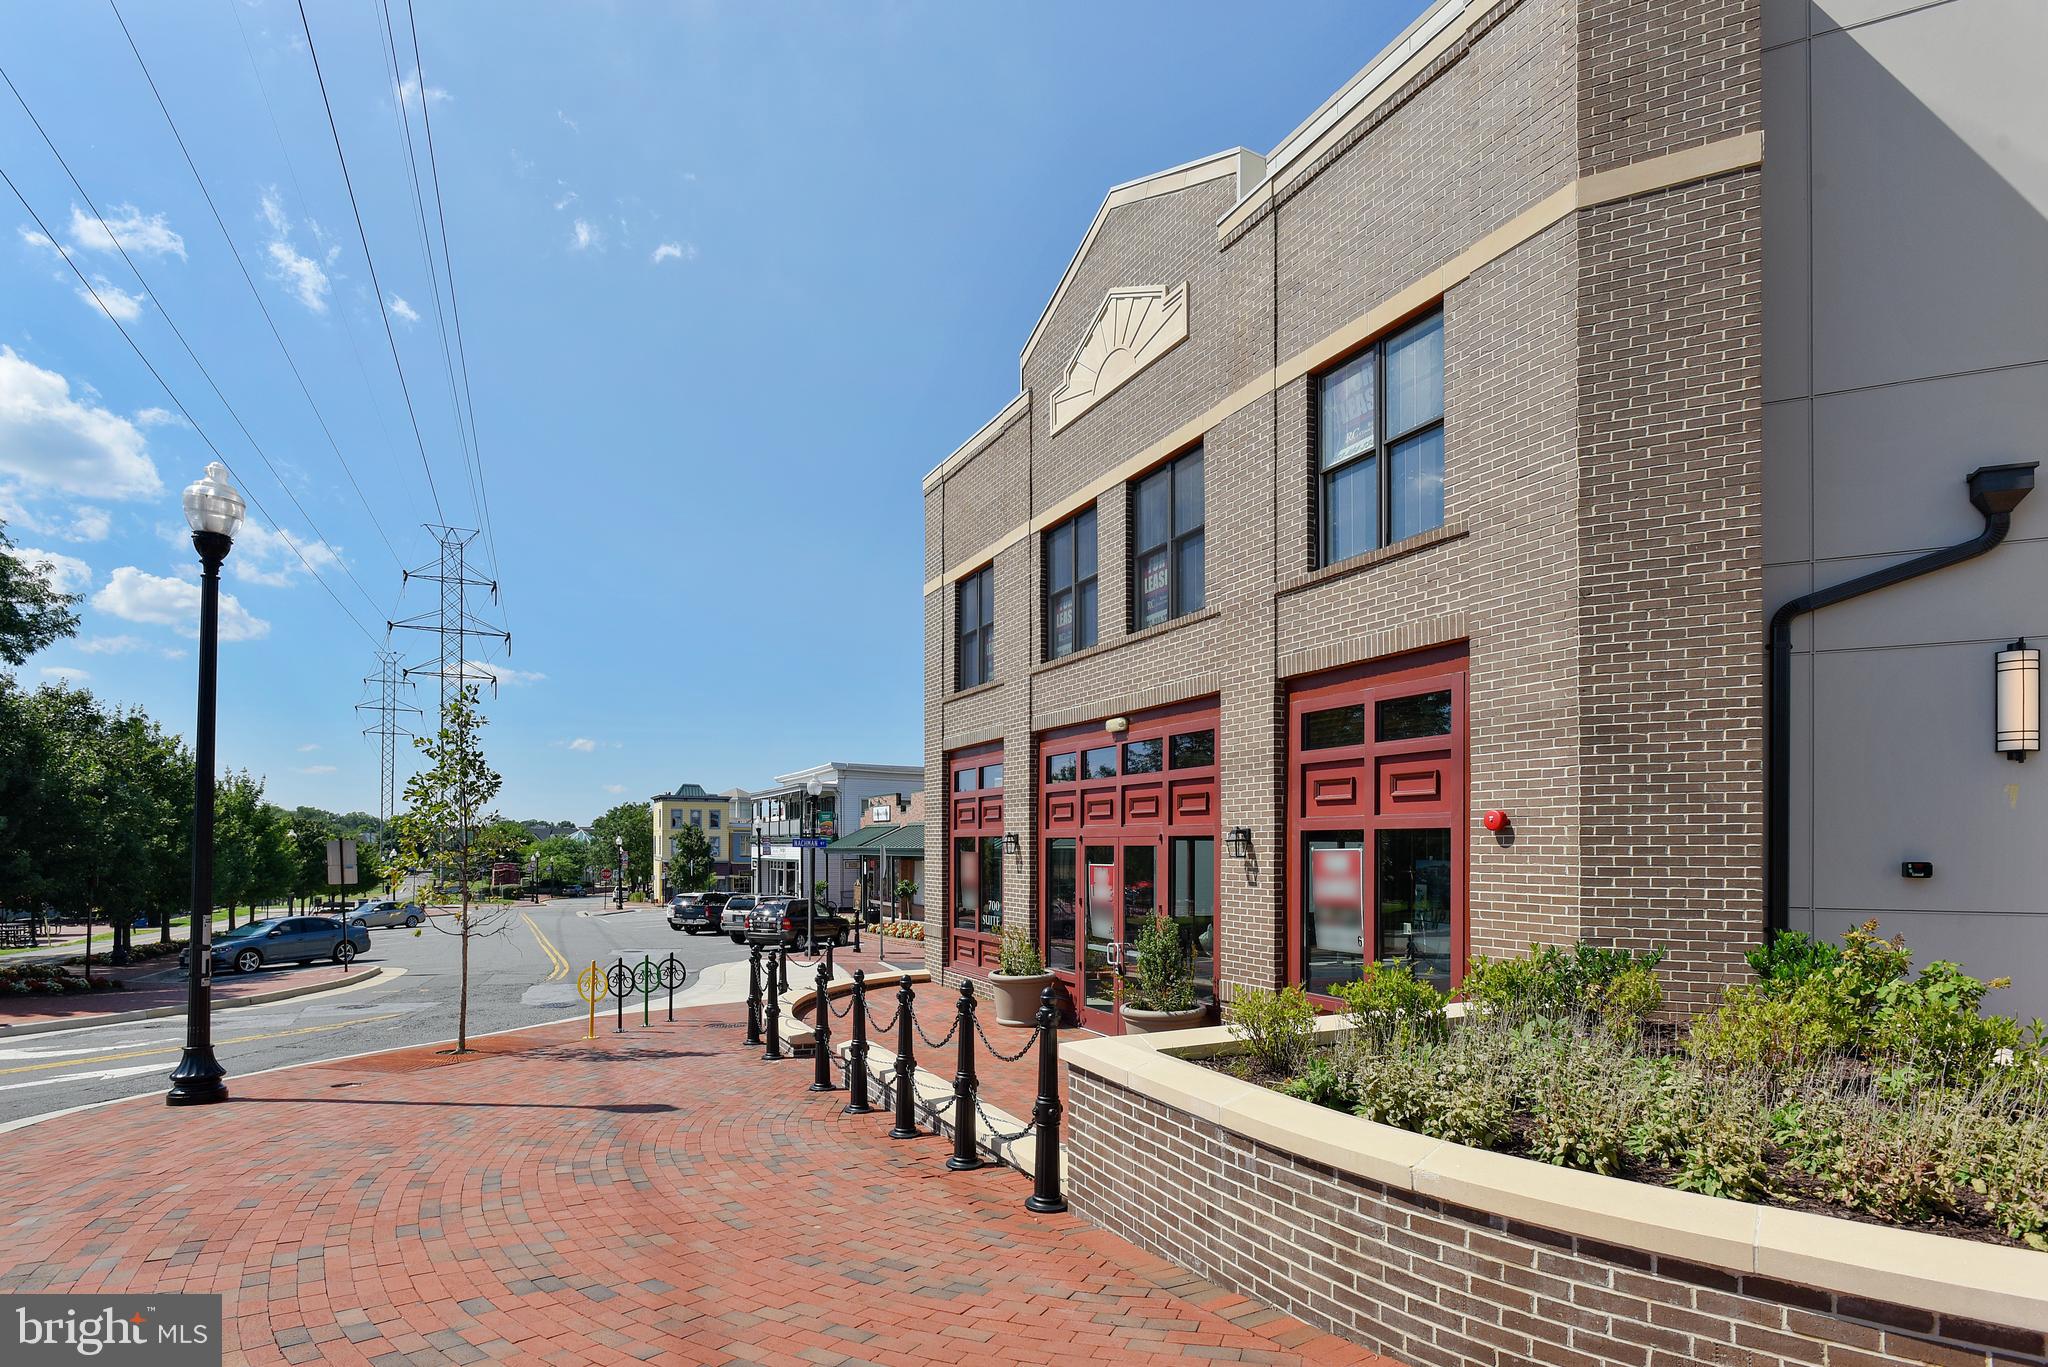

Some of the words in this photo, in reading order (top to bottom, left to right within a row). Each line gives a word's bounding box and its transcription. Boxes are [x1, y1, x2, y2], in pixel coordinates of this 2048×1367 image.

[1342, 386, 1374, 425] LEAS
[1056, 609, 1072, 628] LEAS
[988, 900, 1000, 911] 700
[982, 914, 1000, 926] SUITE
